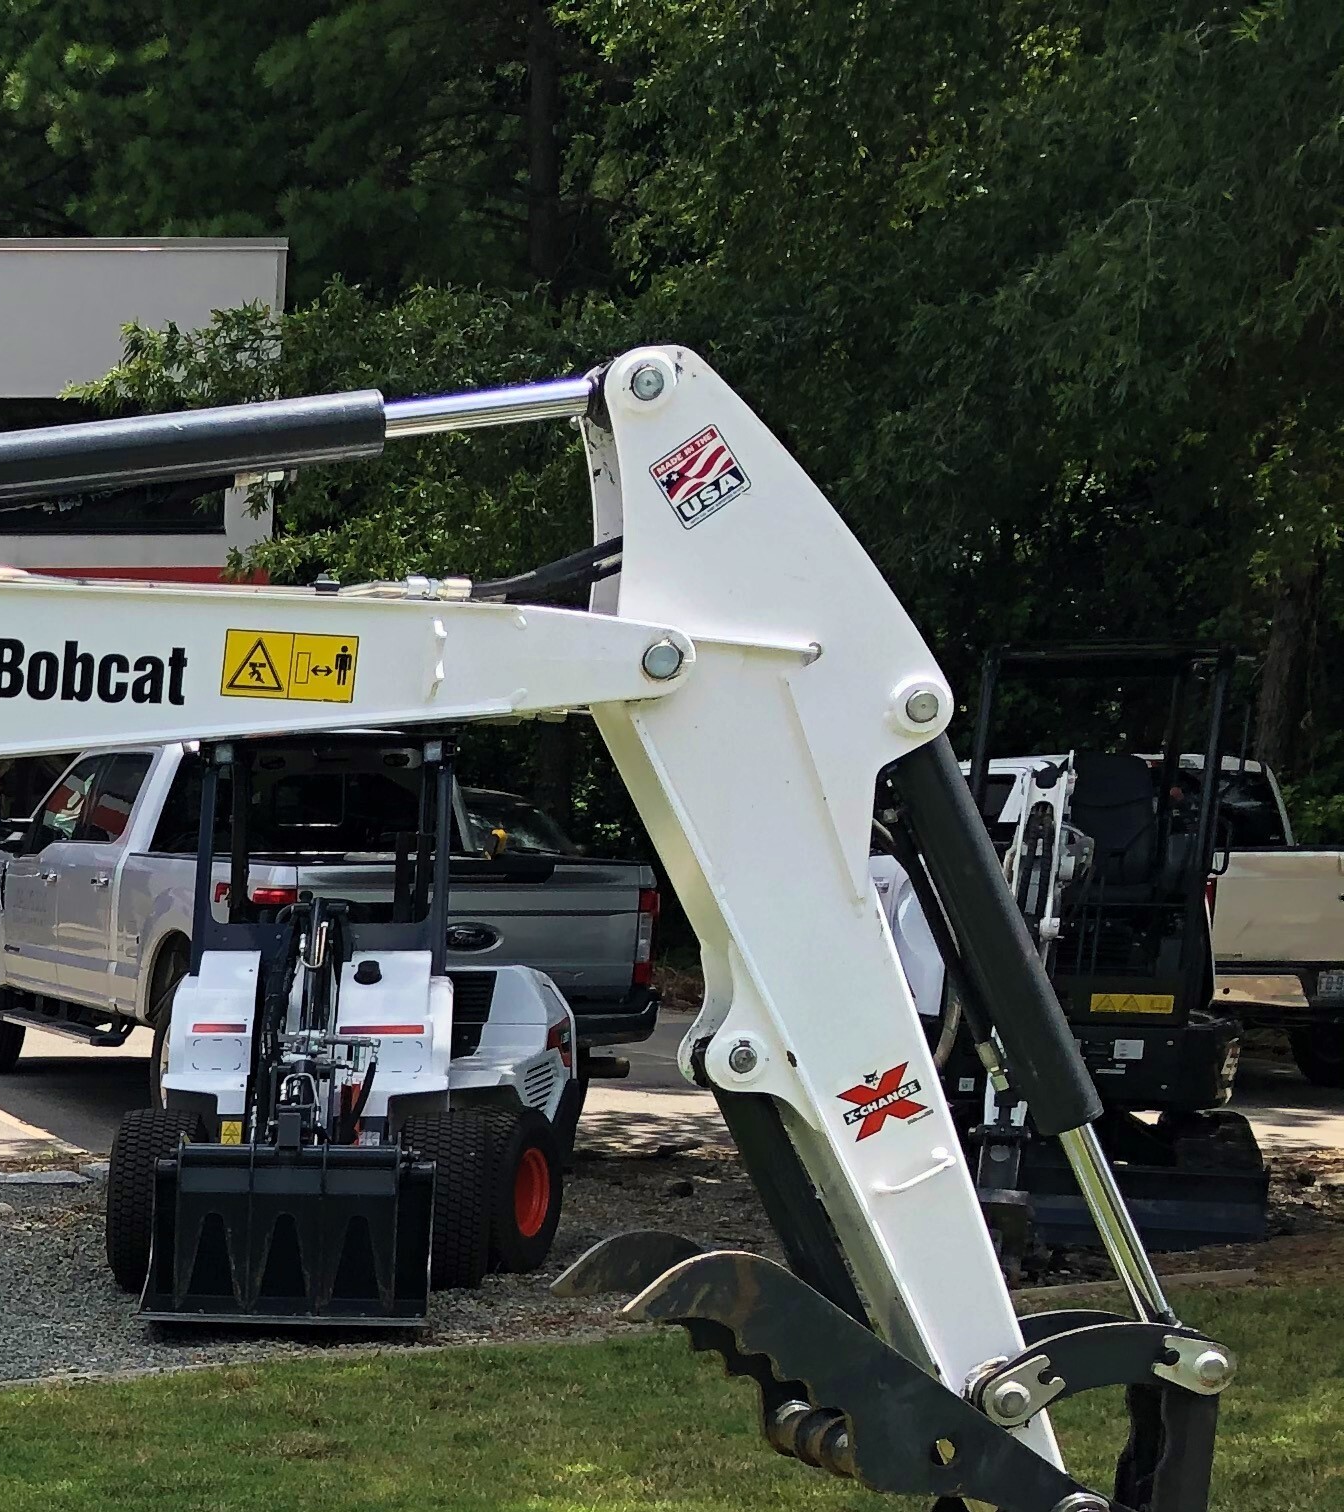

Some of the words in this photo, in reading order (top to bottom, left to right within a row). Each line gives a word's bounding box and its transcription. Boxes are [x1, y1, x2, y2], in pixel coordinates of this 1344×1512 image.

[656, 453, 684, 474] MADE
[683, 444, 695, 457] IN
[694, 431, 713, 448] THE
[679, 473, 741, 518] USA
[845, 1081, 918, 1124] X-CHANGE
